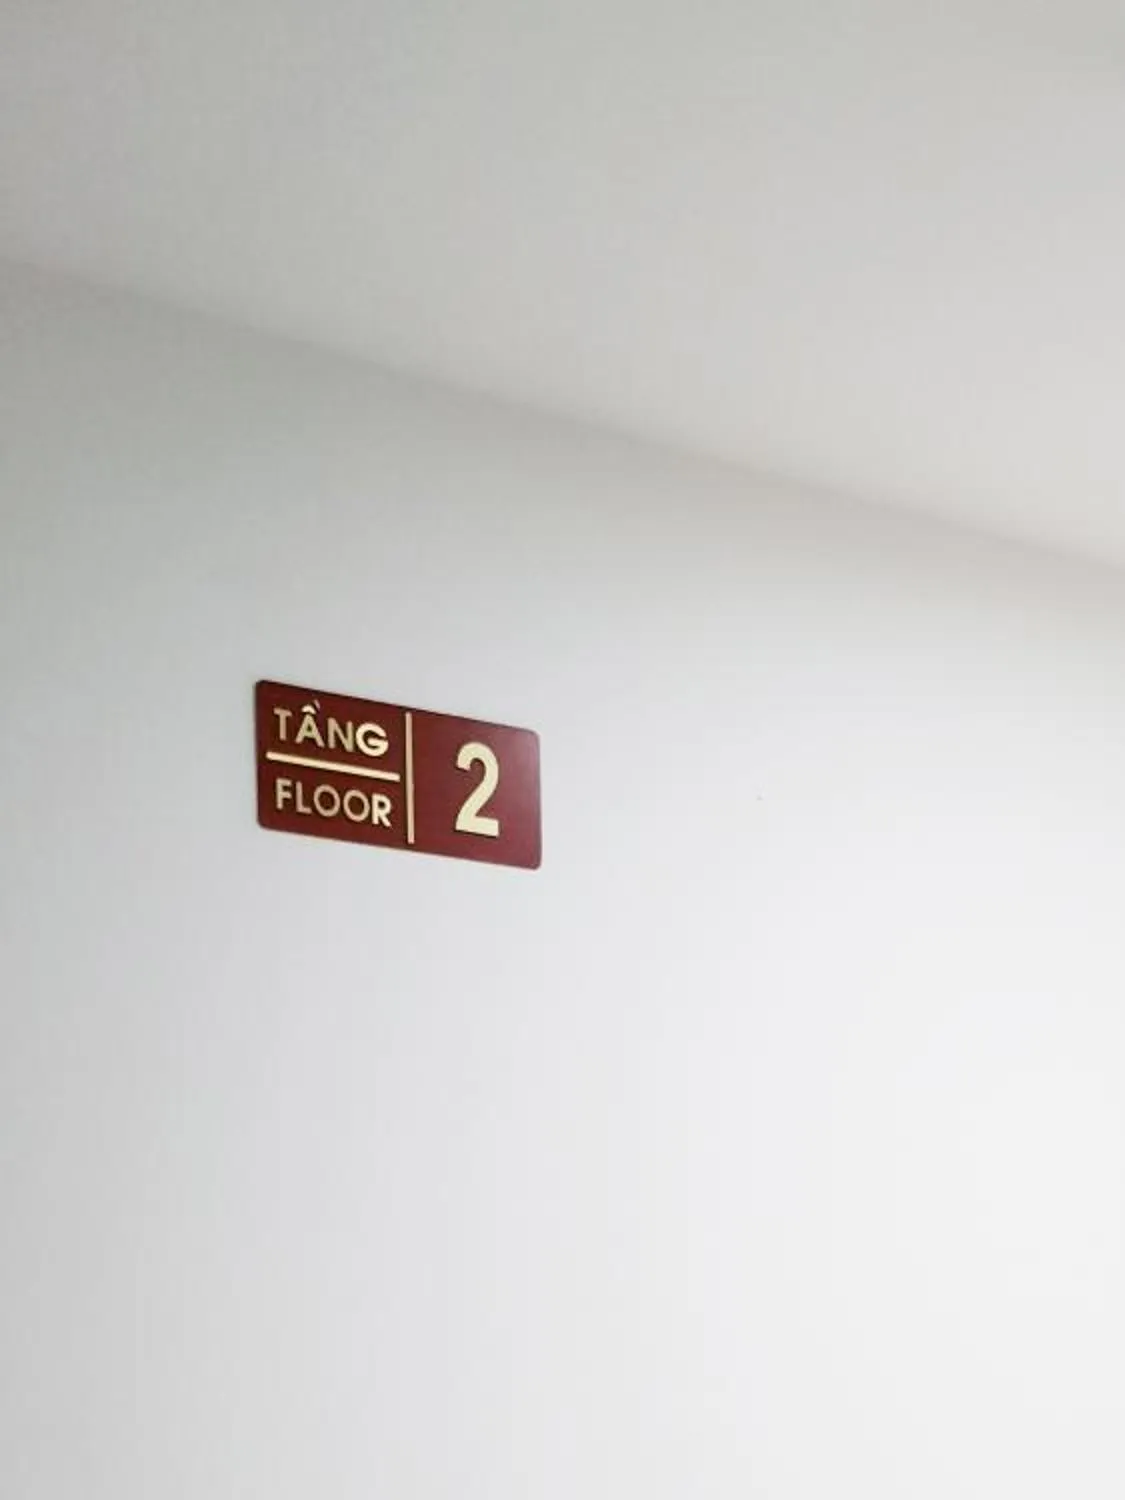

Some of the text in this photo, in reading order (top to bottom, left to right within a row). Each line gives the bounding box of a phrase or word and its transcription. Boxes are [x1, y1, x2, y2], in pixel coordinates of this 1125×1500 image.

[273, 699, 389, 757] TẦNG
[275, 778, 392, 827] FLOOR
[455, 742, 499, 838] 2
